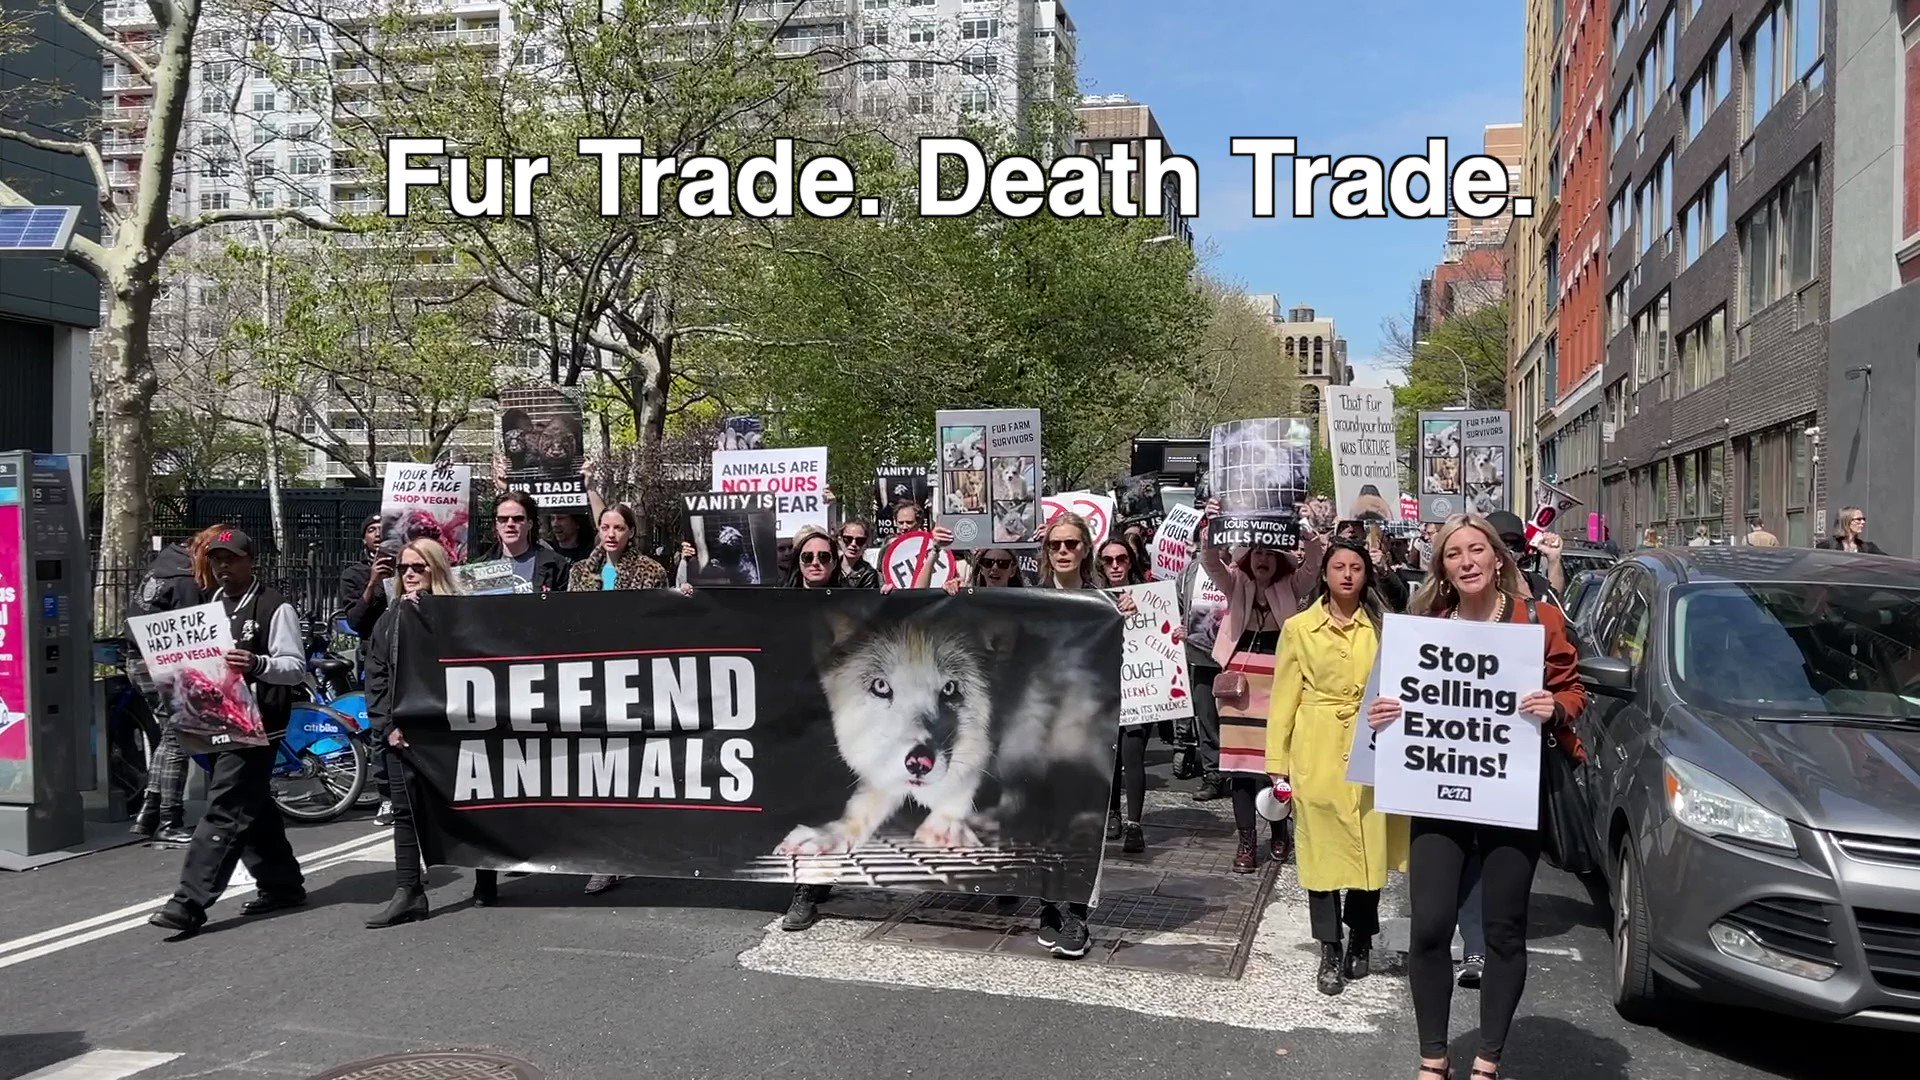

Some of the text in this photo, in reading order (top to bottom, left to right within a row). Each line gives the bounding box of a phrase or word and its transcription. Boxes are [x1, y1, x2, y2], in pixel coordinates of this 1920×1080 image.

[1339, 394, 1382, 412] That fur
[992, 420, 1030, 434] FUR FARM
[1334, 415, 1359, 432] around
[1360, 422, 1377, 439] your
[1466, 415, 1500, 428] FUR FARM
[992, 433, 1034, 448] SURVIVORS
[1466, 427, 1504, 439] SURVIVORS
[1341, 439, 1391, 455] was TORTURE
[399, 468, 455, 480] YOUR FUR
[722, 461, 818, 476] ANIMALS ARE
[876, 466, 926, 476] VANITY IS
[1339, 457, 1397, 478] to an animal!
[392, 481, 461, 492] HAD A FACE
[535, 482, 581, 493] TRADE
[722, 476, 818, 493] NOT OURS
[393, 494, 458, 505] SHOP VEGAN
[545, 495, 582, 505] TRADE
[685, 495, 773, 511] VANITY IS
[779, 496, 818, 513] EAR
[1169, 509, 1198, 527] WEAR
[1224, 519, 1287, 532] LOUIS VUITTON
[1163, 524, 1188, 541] YOUR
[1213, 530, 1296, 546] KILLS FOXES
[1159, 538, 1185, 559] OWN
[1157, 554, 1184, 573] SKIN
[1202, 592, 1225, 602] SHOP
[145, 611, 205, 638] YOUR FUR
[147, 624, 218, 653] HAD A FACE
[1127, 639, 1139, 653] S
[156, 647, 222, 665] SHOP VEGAN
[1144, 634, 1182, 663] CELINE
[1418, 643, 1499, 680] Stop
[1121, 660, 1164, 681] OUGH
[445, 656, 756, 732] DEFEND
[1399, 676, 1517, 716] Selling
[1404, 711, 1511, 745] Exotic
[454, 738, 754, 802] ANIMALS
[1404, 745, 1508, 779] Skins!
